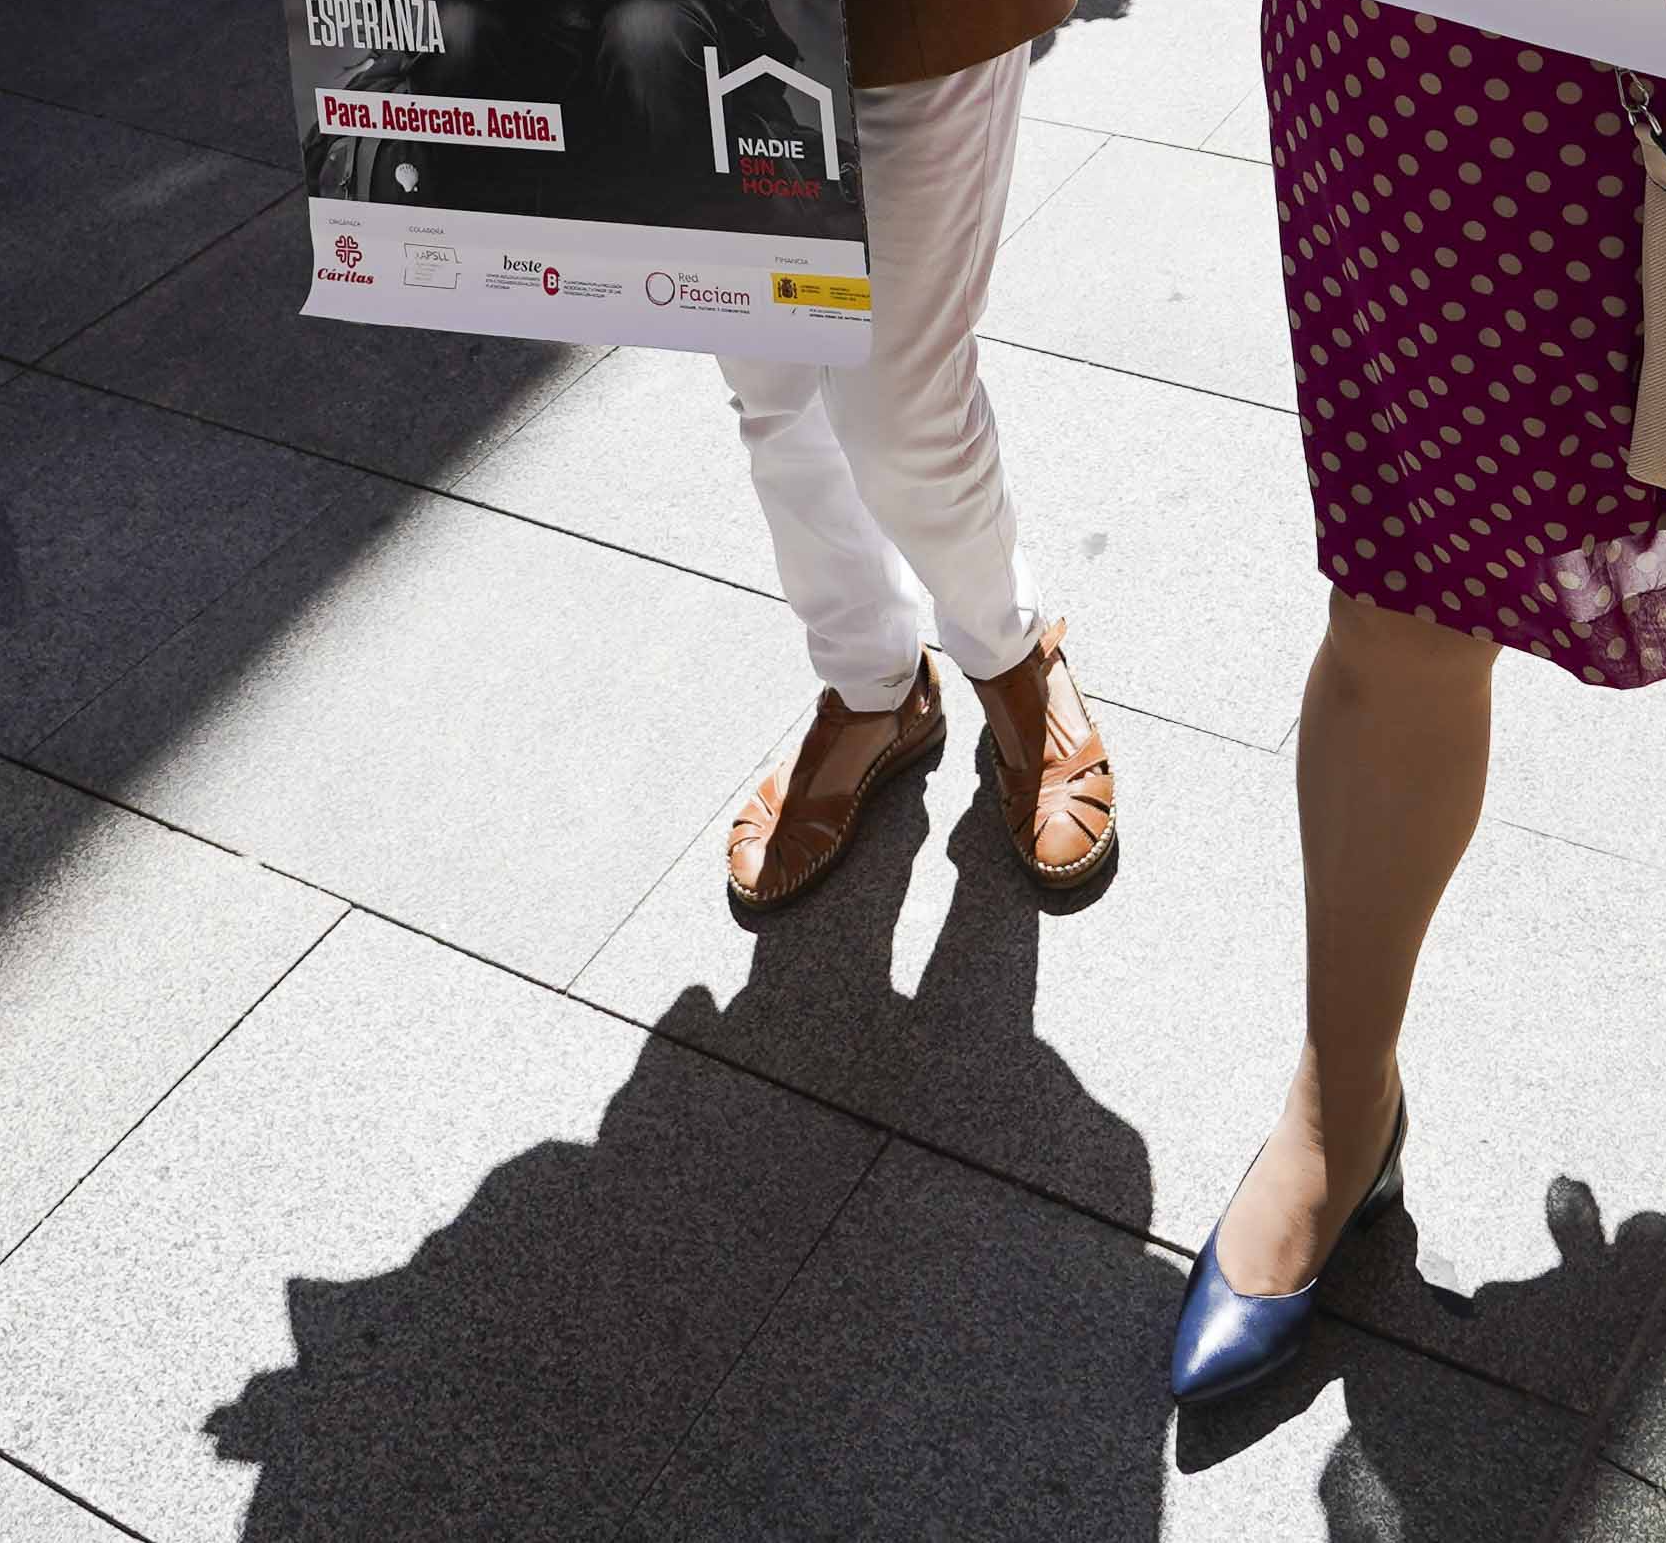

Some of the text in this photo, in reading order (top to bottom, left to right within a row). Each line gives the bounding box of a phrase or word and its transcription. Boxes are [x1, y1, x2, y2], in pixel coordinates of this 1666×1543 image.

[324, 96, 556, 142] Para. Acércate. Actúa.
[738, 137, 804, 159] NADIE
[740, 158, 775, 177] SIN
[742, 178, 822, 200] HOGAR
[317, 268, 374, 285] Cáritas
[678, 273, 698, 283] Red
[681, 285, 749, 305] Faciam
